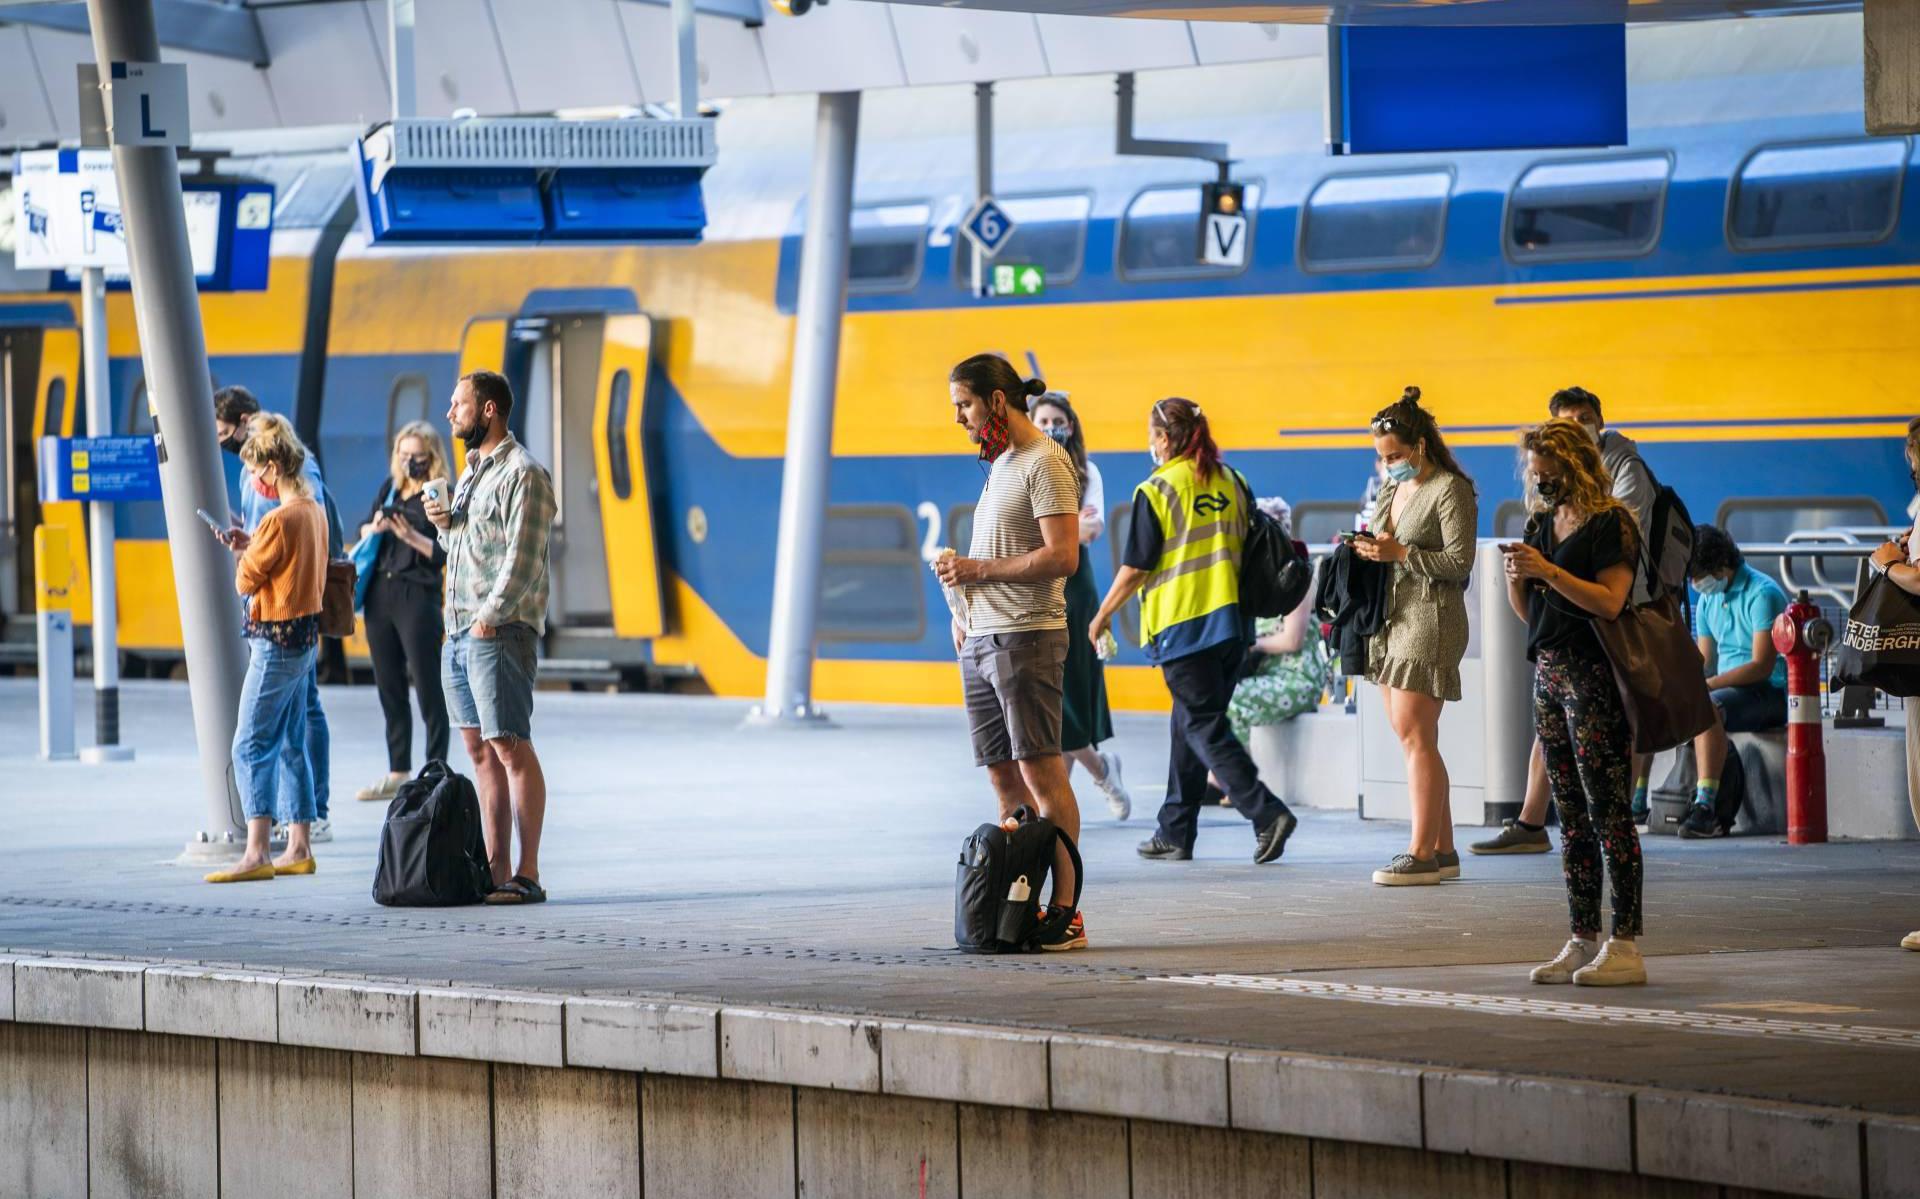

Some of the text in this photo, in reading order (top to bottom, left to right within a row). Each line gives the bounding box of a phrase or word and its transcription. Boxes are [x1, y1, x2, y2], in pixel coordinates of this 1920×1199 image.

[141, 93, 166, 138] L
[928, 194, 961, 247] 2
[981, 209, 1000, 240] 6
[1214, 221, 1240, 257] V
[917, 501, 946, 561] 2
[1846, 618, 1880, 638] PETER
